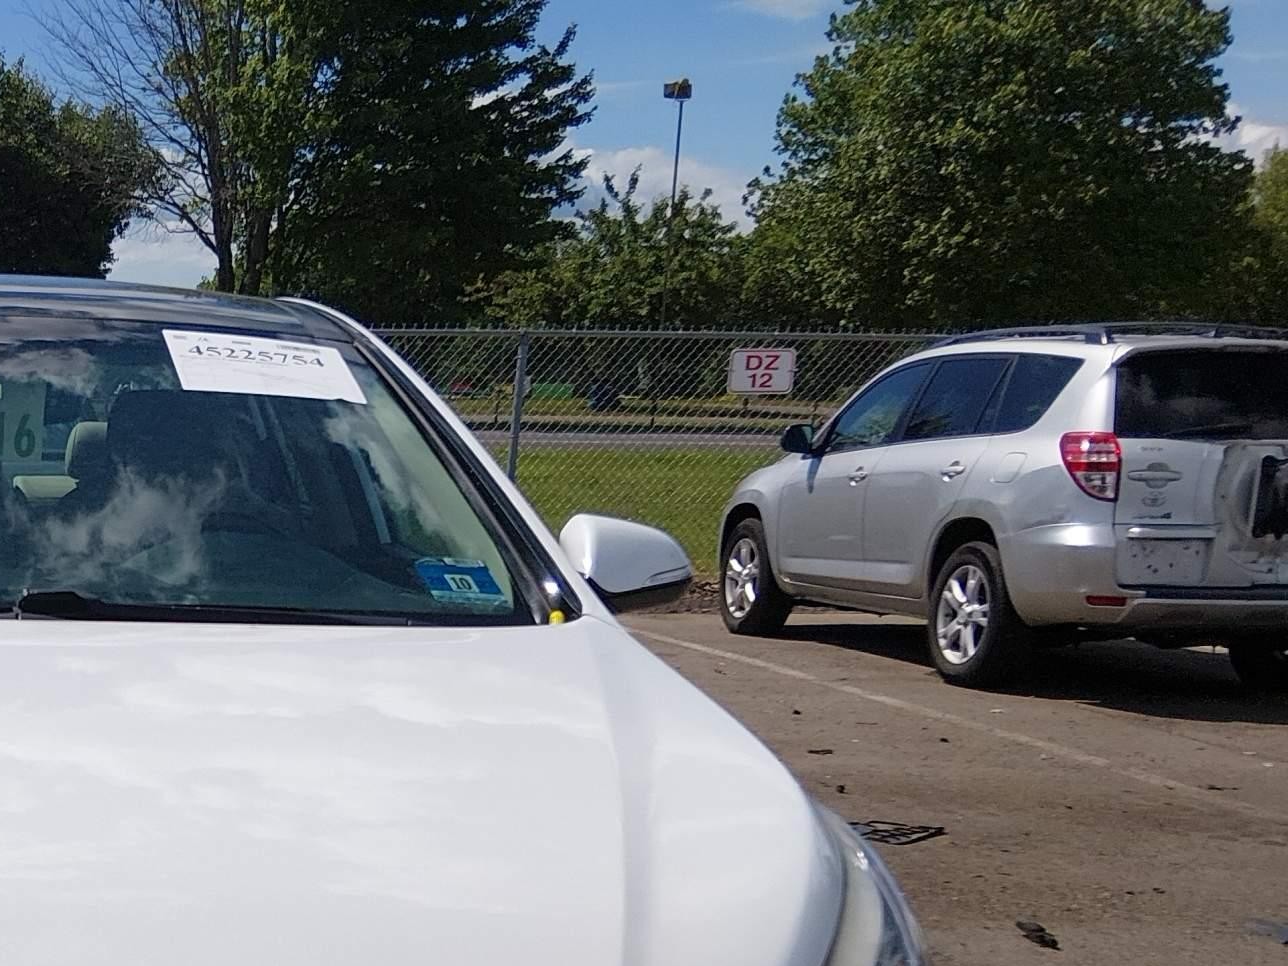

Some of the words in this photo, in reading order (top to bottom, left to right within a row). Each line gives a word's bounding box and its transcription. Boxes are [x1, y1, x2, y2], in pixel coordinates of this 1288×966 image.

[188, 345, 324, 367] 45225754
[745, 354, 780, 371] DZ
[747, 373, 772, 388] 12
[451, 576, 472, 591] 10
